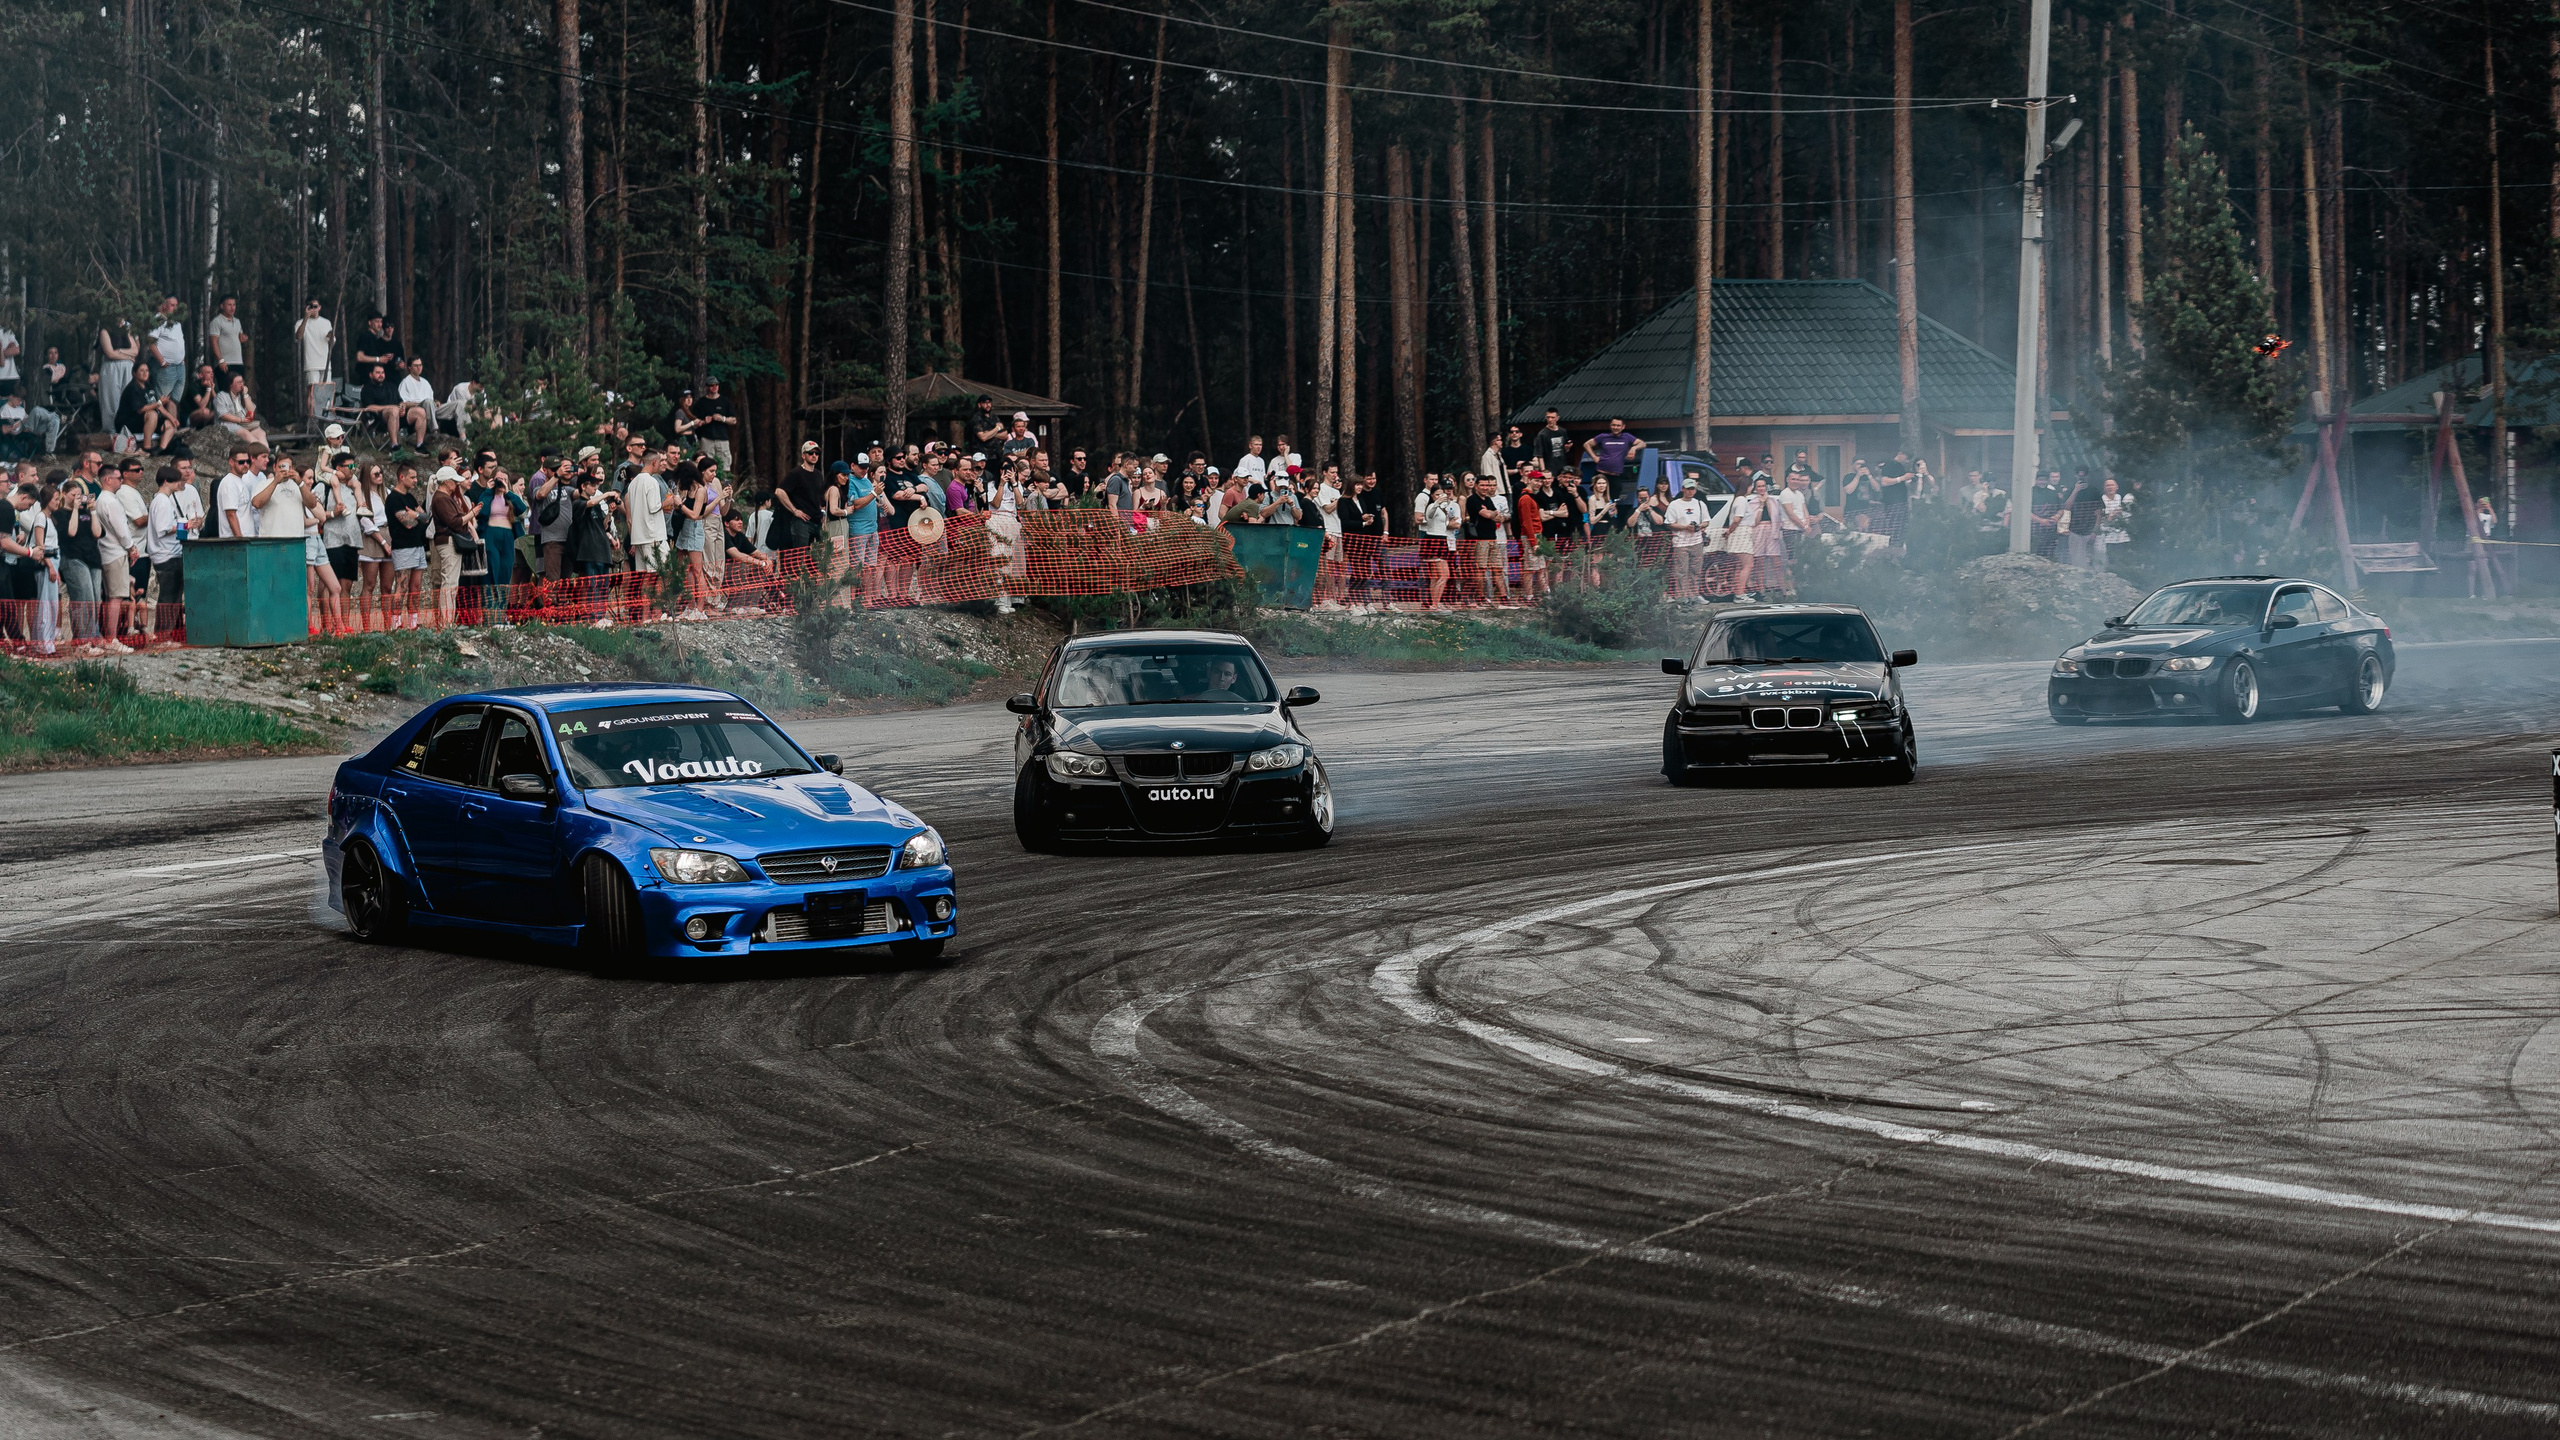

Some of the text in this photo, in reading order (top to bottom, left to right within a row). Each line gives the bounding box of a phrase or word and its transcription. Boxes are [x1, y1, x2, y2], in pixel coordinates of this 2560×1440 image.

[1783, 680, 1857, 688] detailing
[558, 721, 588, 735] 44
[622, 755, 762, 783] Voauto
[1148, 787, 1214, 801] auto.ru
